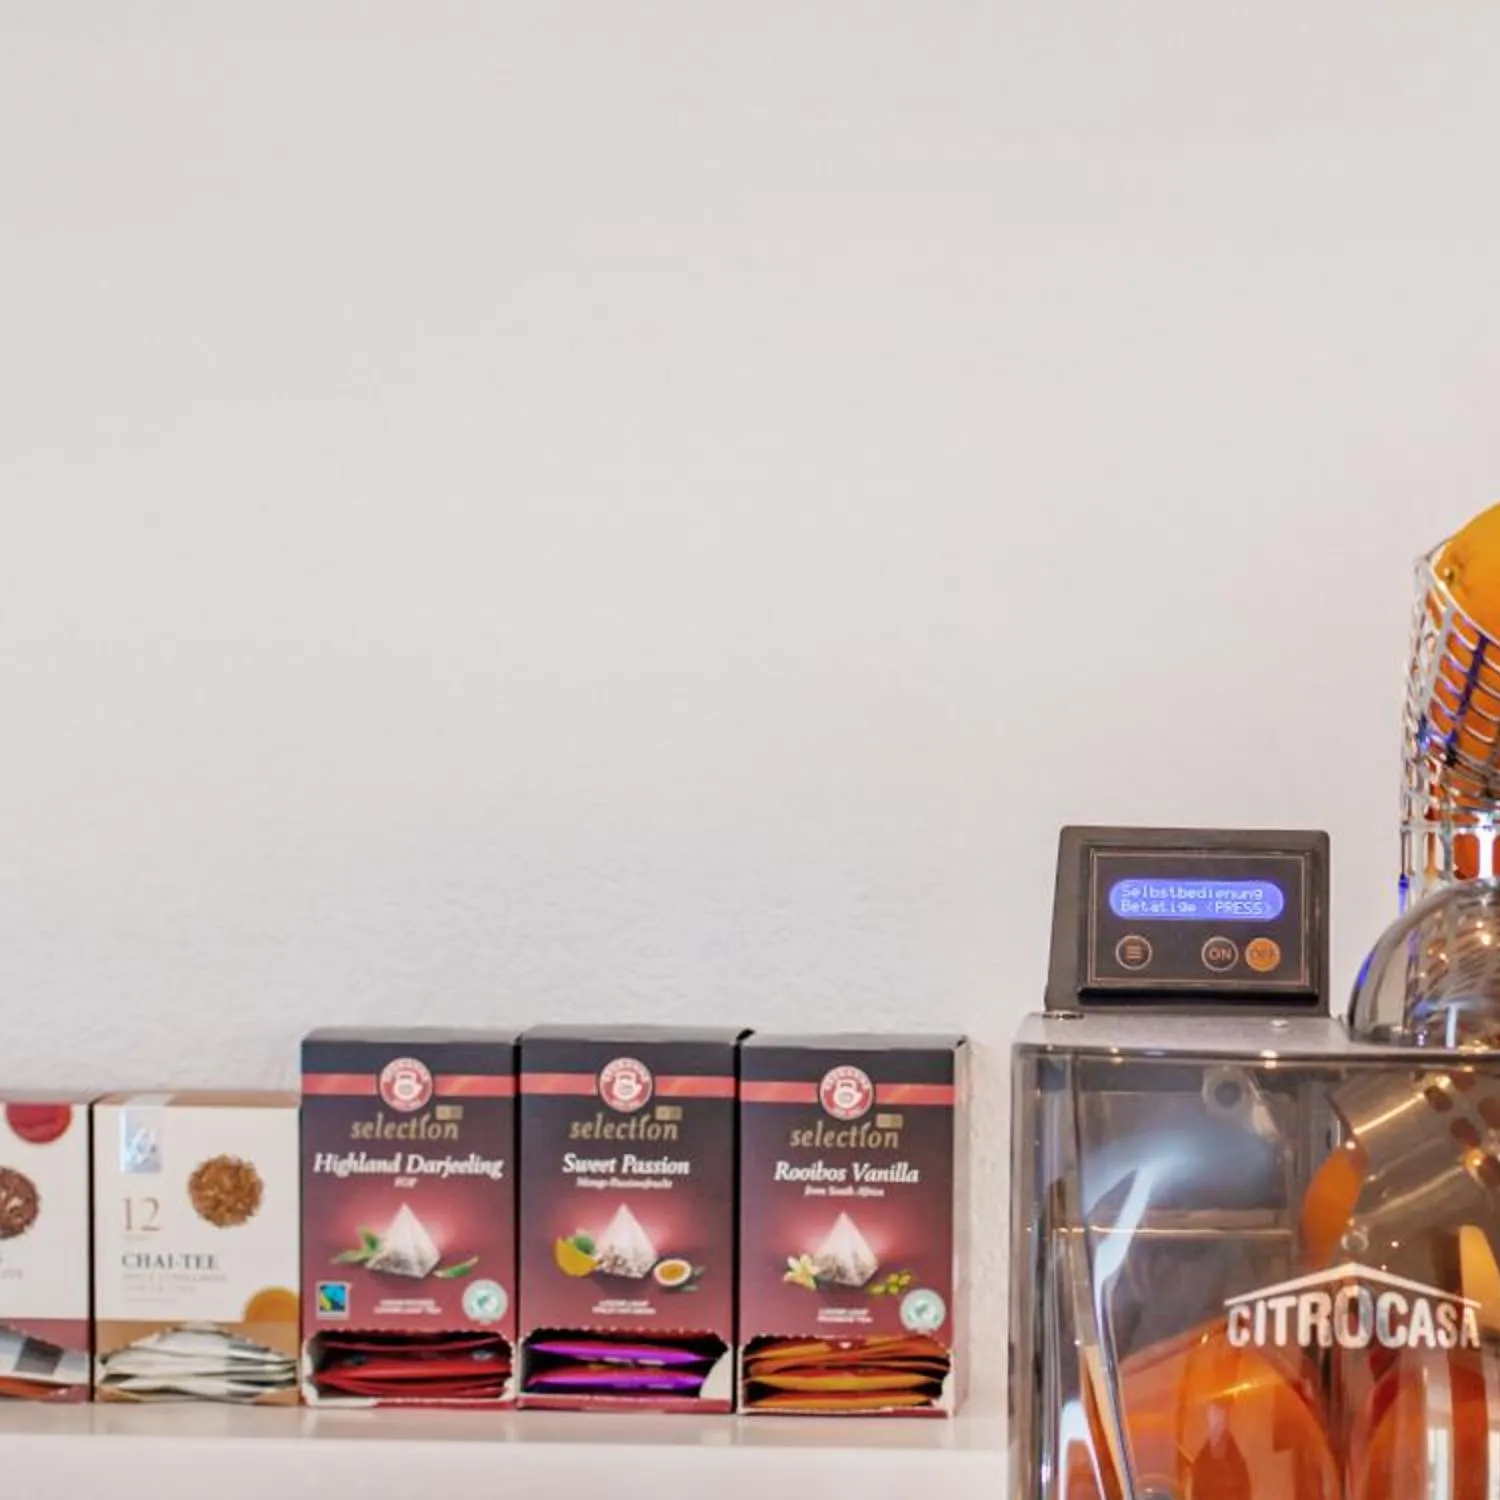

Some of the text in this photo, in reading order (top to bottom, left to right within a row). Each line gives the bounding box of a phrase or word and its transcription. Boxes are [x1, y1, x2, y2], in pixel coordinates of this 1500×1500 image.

[351, 1111, 459, 1141] selection
[569, 1112, 678, 1141] selection
[790, 1119, 899, 1149] selection
[313, 1152, 504, 1180] Highland Darjeeling
[562, 1152, 690, 1175] Sweet Passion
[774, 1160, 919, 1184] Rooibos Vanilla
[124, 1197, 161, 1232] 12
[1227, 1284, 1482, 1349] CITROCASA
